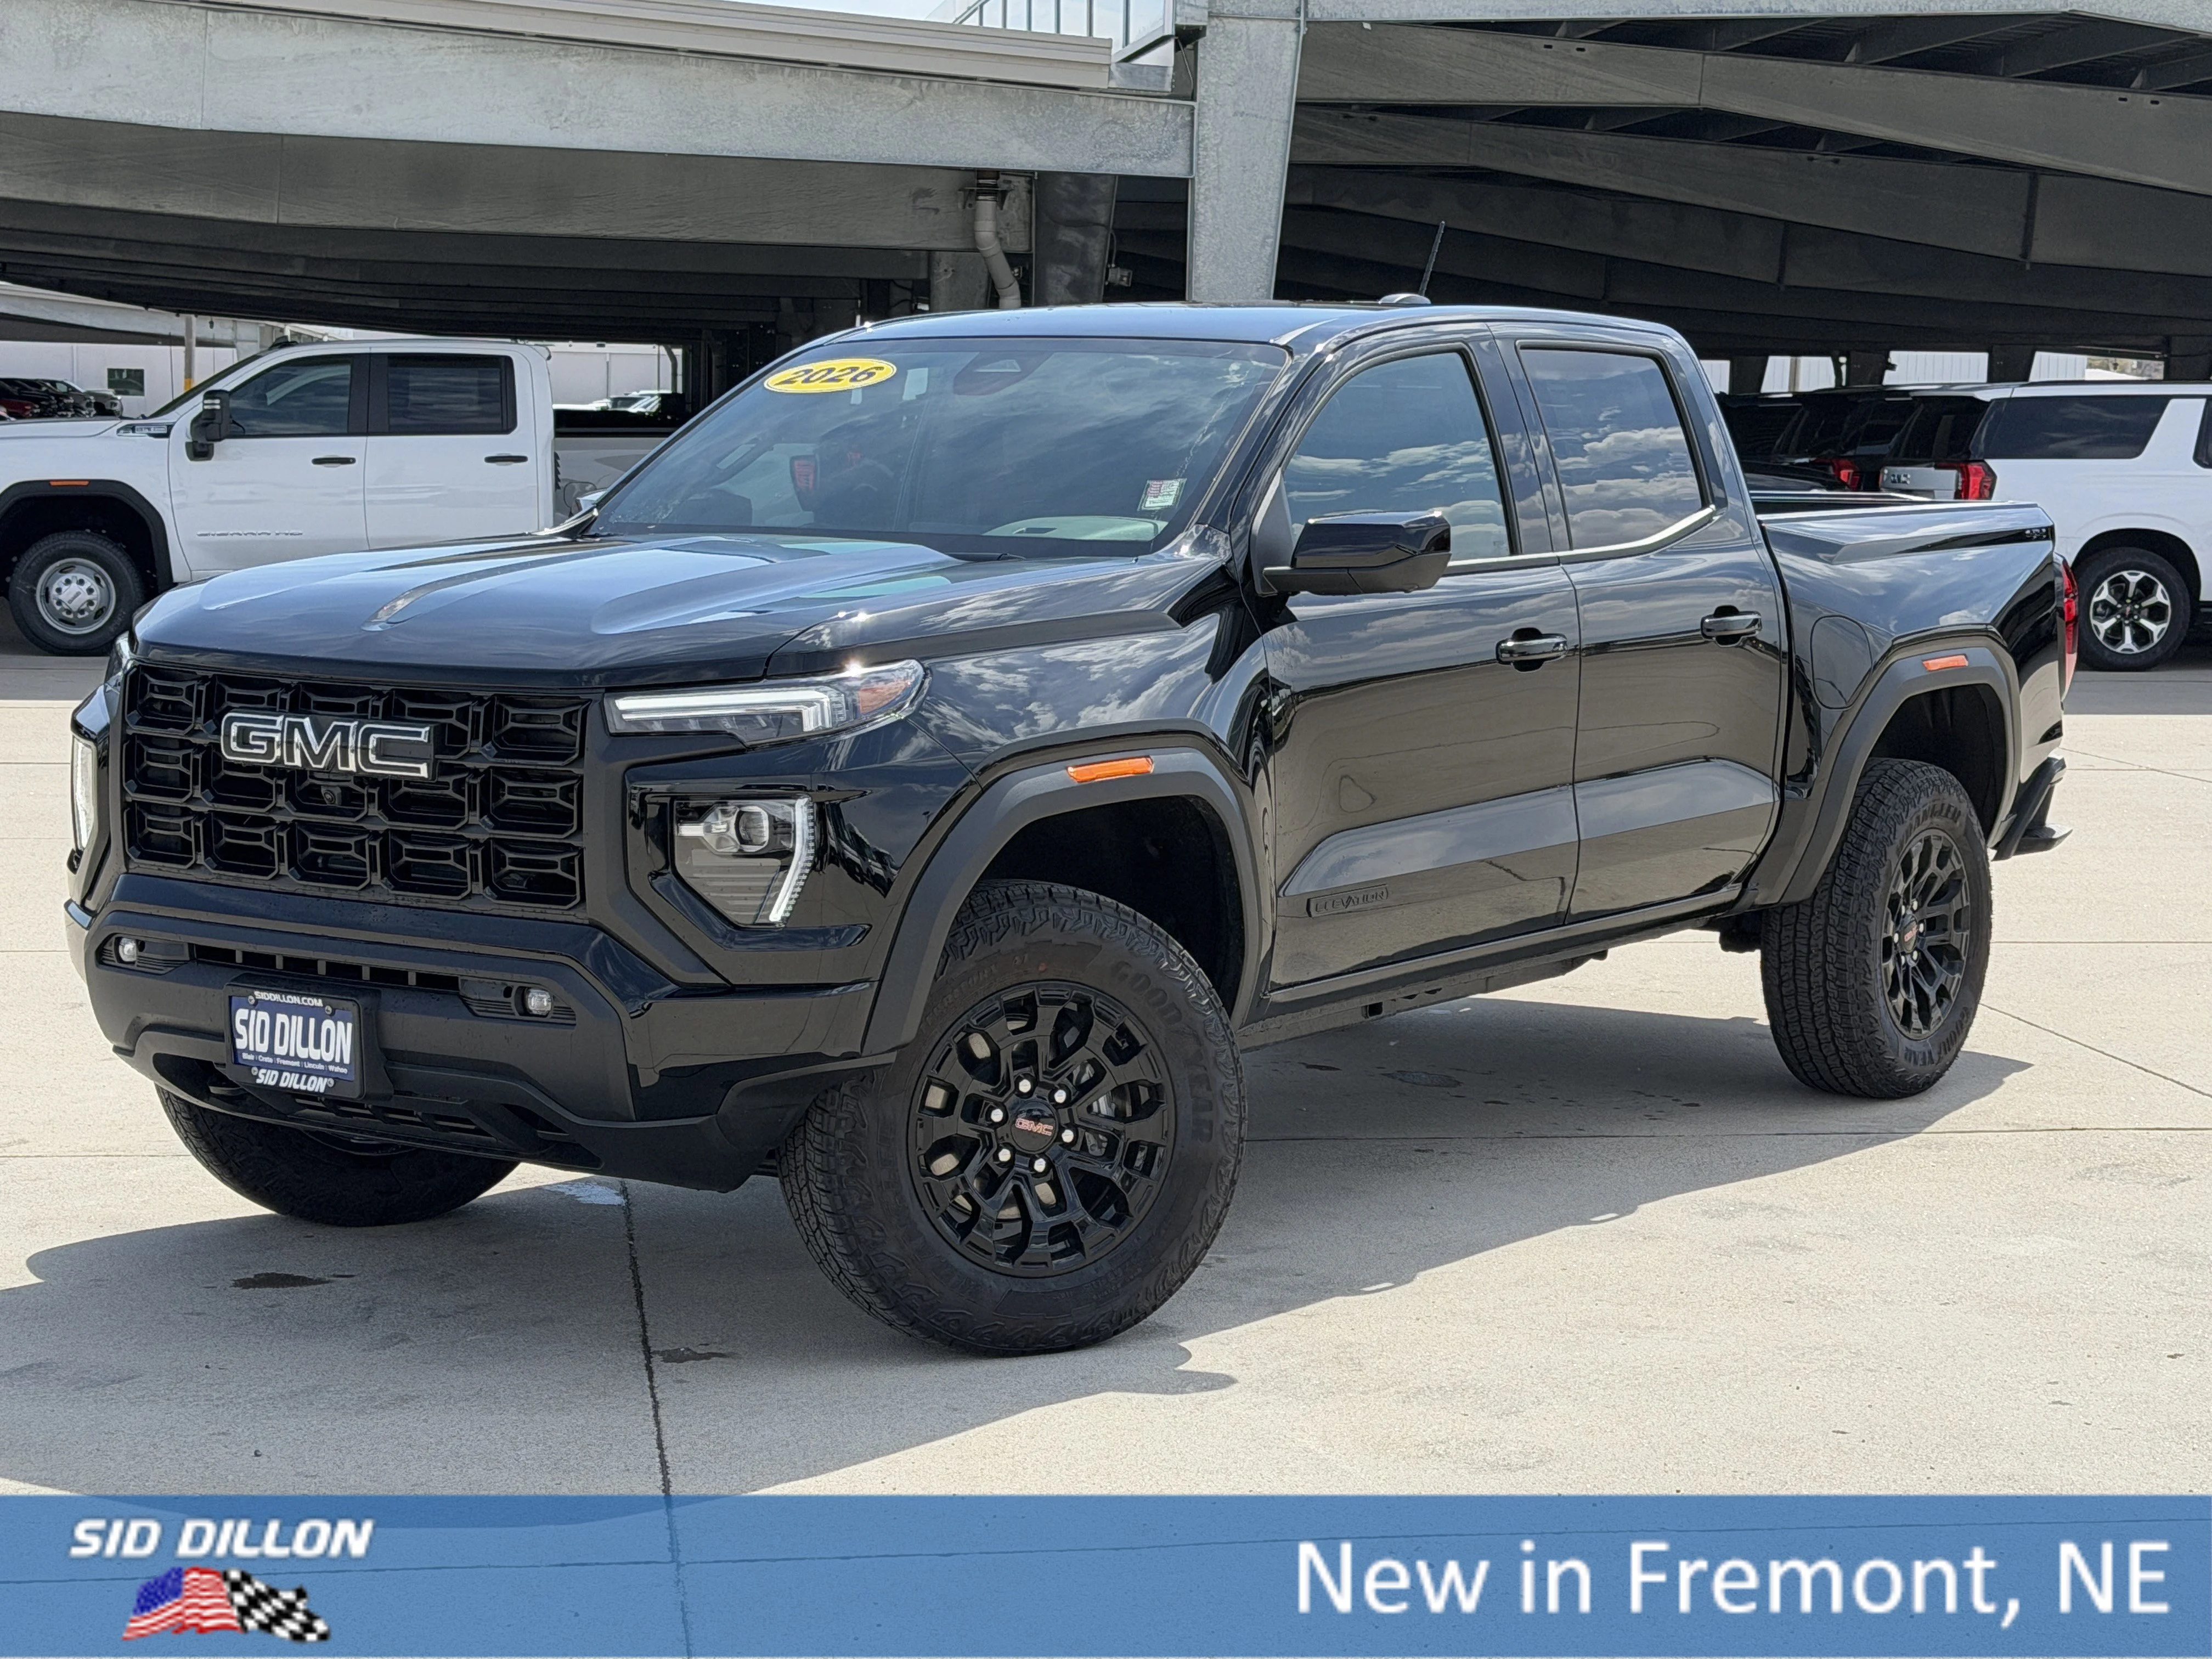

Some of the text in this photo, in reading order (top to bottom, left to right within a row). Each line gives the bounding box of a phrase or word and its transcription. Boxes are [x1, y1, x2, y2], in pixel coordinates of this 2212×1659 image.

[774, 366, 884, 386] 2026
[221, 712, 430, 778] GMC
[254, 991, 324, 1007] SIDDILLON.COM
[235, 1008, 353, 1064] SID DILLON
[256, 1068, 328, 1093] SID DILLON
[1015, 1118, 1054, 1137] GMC
